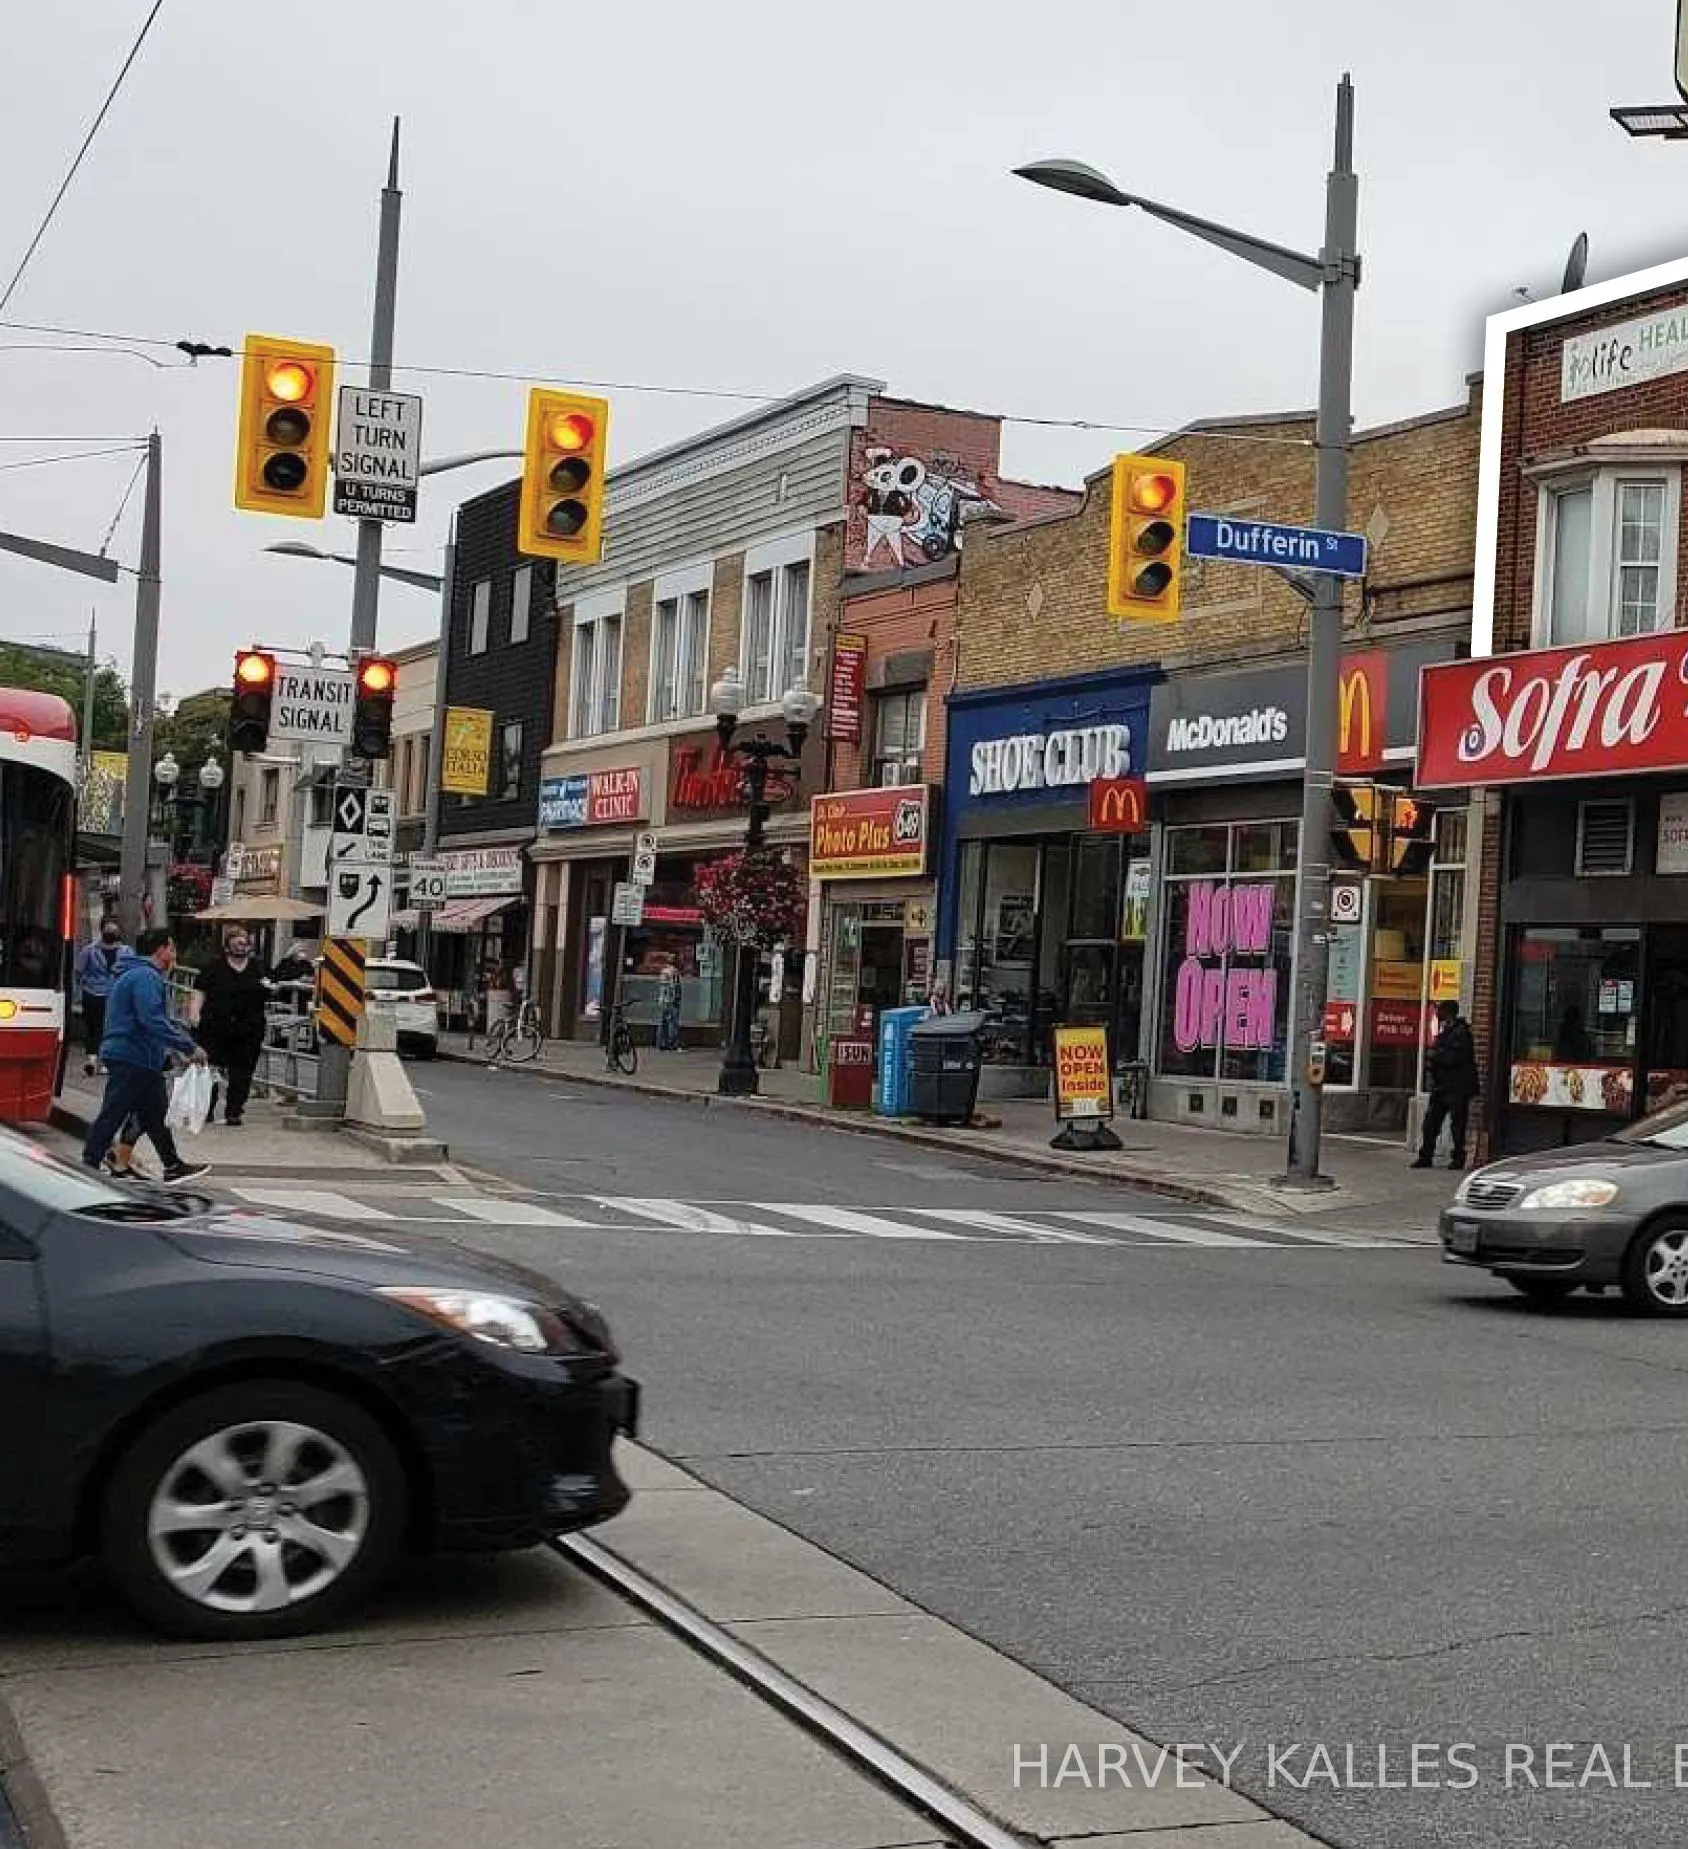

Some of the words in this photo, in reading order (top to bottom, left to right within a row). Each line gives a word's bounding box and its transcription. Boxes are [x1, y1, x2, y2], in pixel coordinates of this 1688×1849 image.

[355, 396, 405, 421] LEFT
[353, 425, 406, 449] TURN
[341, 453, 413, 480] SIGNAL
[345, 482, 356, 496] U
[361, 485, 406, 501] TURNS
[338, 499, 411, 519] PERMITTED
[1217, 520, 1320, 560] Dufferin
[278, 676, 351, 704] TRANSIT
[279, 706, 343, 732] SIGNAL
[1458, 653, 1667, 773] Sofra
[1167, 706, 1287, 752] McDonald's
[970, 734, 1045, 796] SHOE
[1045, 724, 1130, 787] CLUB
[591, 771, 637, 796] WALK-IN
[595, 794, 634, 818] CLINIC
[815, 823, 855, 854] Photo
[859, 820, 889, 850] Plus
[414, 877, 443, 895] 40
[1186, 881, 1276, 958] NOW
[1174, 957, 1278, 1053] OPEN
[1377, 1010, 1406, 1022] Driver
[1061, 1045, 1104, 1060] NOW
[1060, 1061, 1104, 1076] OPEN
[1062, 1078, 1105, 1092] Inside
